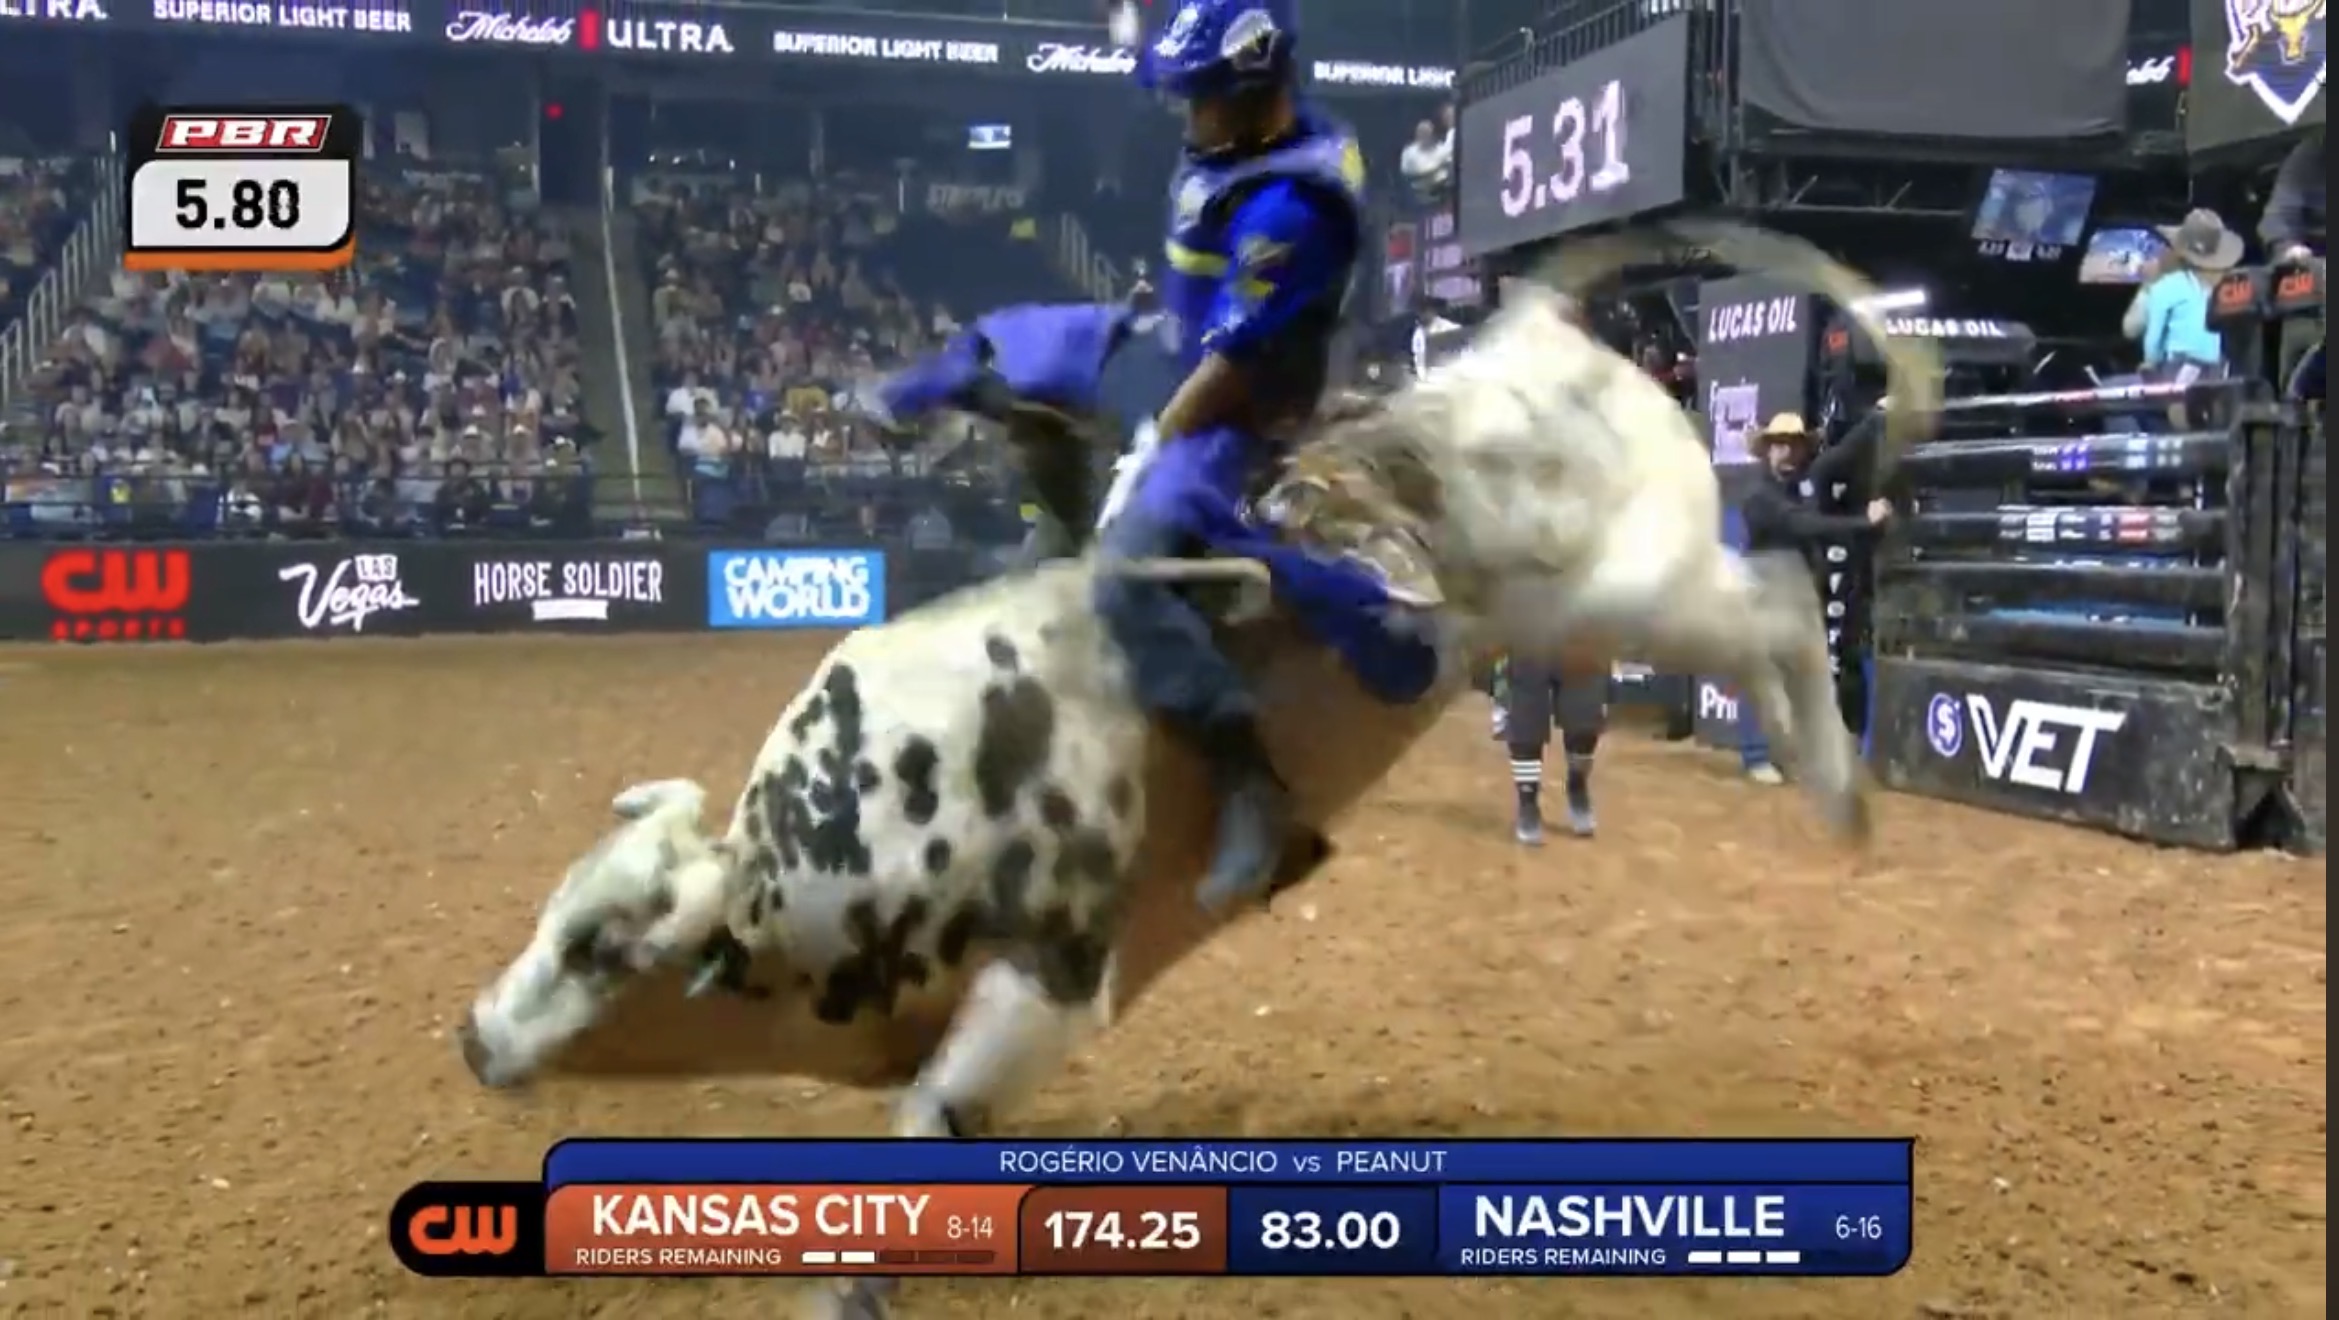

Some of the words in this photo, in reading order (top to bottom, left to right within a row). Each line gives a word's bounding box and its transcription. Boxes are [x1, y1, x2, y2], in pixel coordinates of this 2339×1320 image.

[0, 0, 108, 19] LTRA
[154, 0, 271, 24] SUPERIOR
[278, 6, 349, 28] LIGHT
[353, 9, 412, 32] BEER
[446, 11, 575, 44] Michelob
[607, 18, 734, 52] ULTRA
[882, 38, 943, 60] LIGHT
[1502, 80, 1629, 216] 5.31
[1708, 301, 1766, 343] LUCAS
[1767, 295, 1797, 335] OIL
[1965, 318, 2007, 338] OIL
[41, 548, 191, 614] CW
[358, 556, 395, 579] LAS
[474, 561, 552, 606] HORSE
[563, 560, 662, 602] SOLDIER
[724, 556, 870, 587] CAMPING
[279, 559, 420, 632] Vegas
[727, 583, 871, 619] WORLD
[1966, 693, 2127, 794] VET
